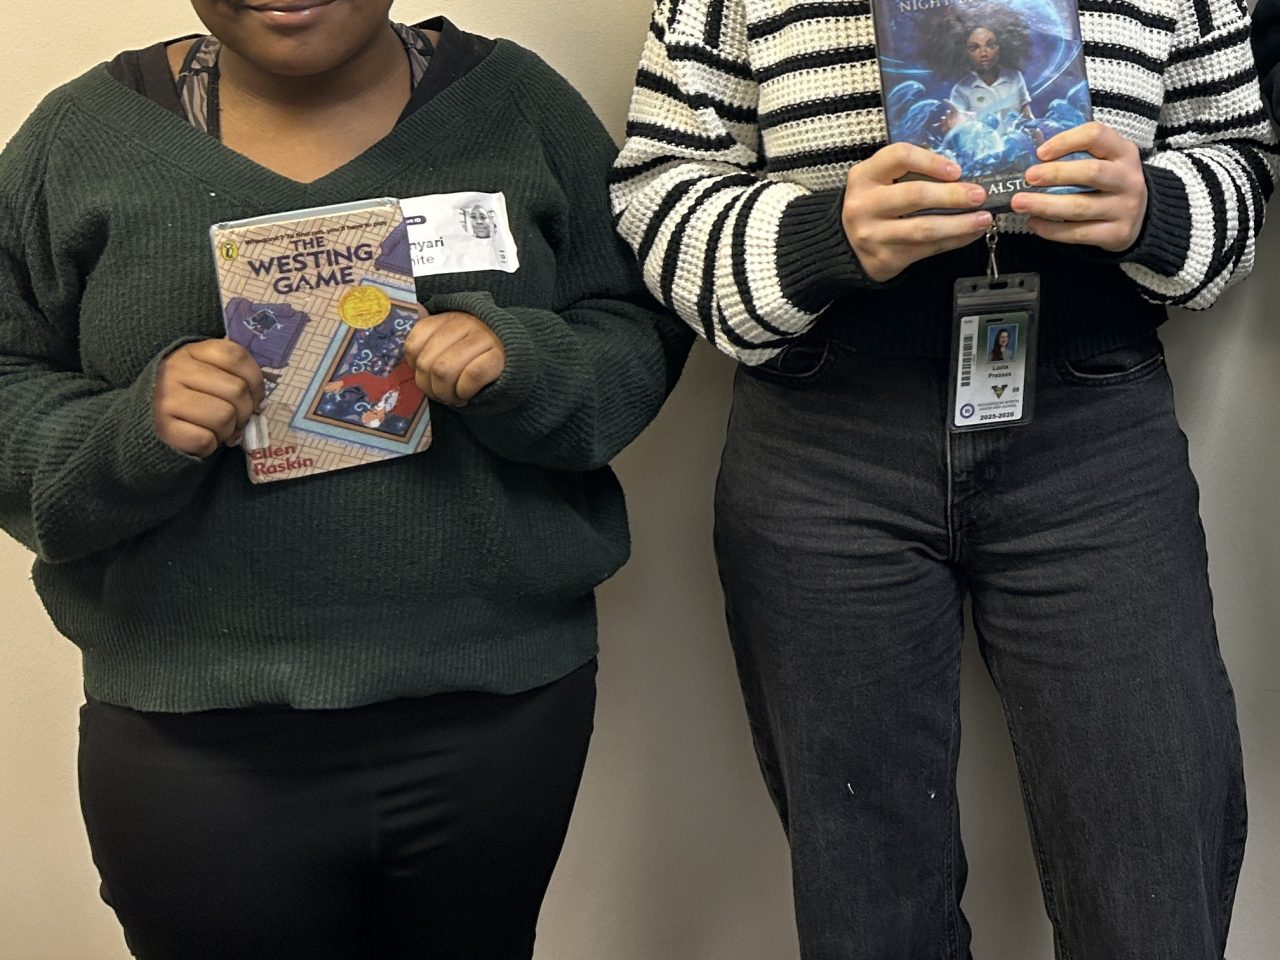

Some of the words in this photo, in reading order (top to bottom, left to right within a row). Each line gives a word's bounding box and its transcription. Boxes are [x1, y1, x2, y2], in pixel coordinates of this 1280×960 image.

[988, 178, 1032, 195] ALSTO
[290, 235, 326, 252] THE
[247, 243, 374, 278] WESTING
[273, 266, 355, 296] GAME
[979, 411, 1015, 421] 2025-2026
[253, 456, 314, 476] Raskin
